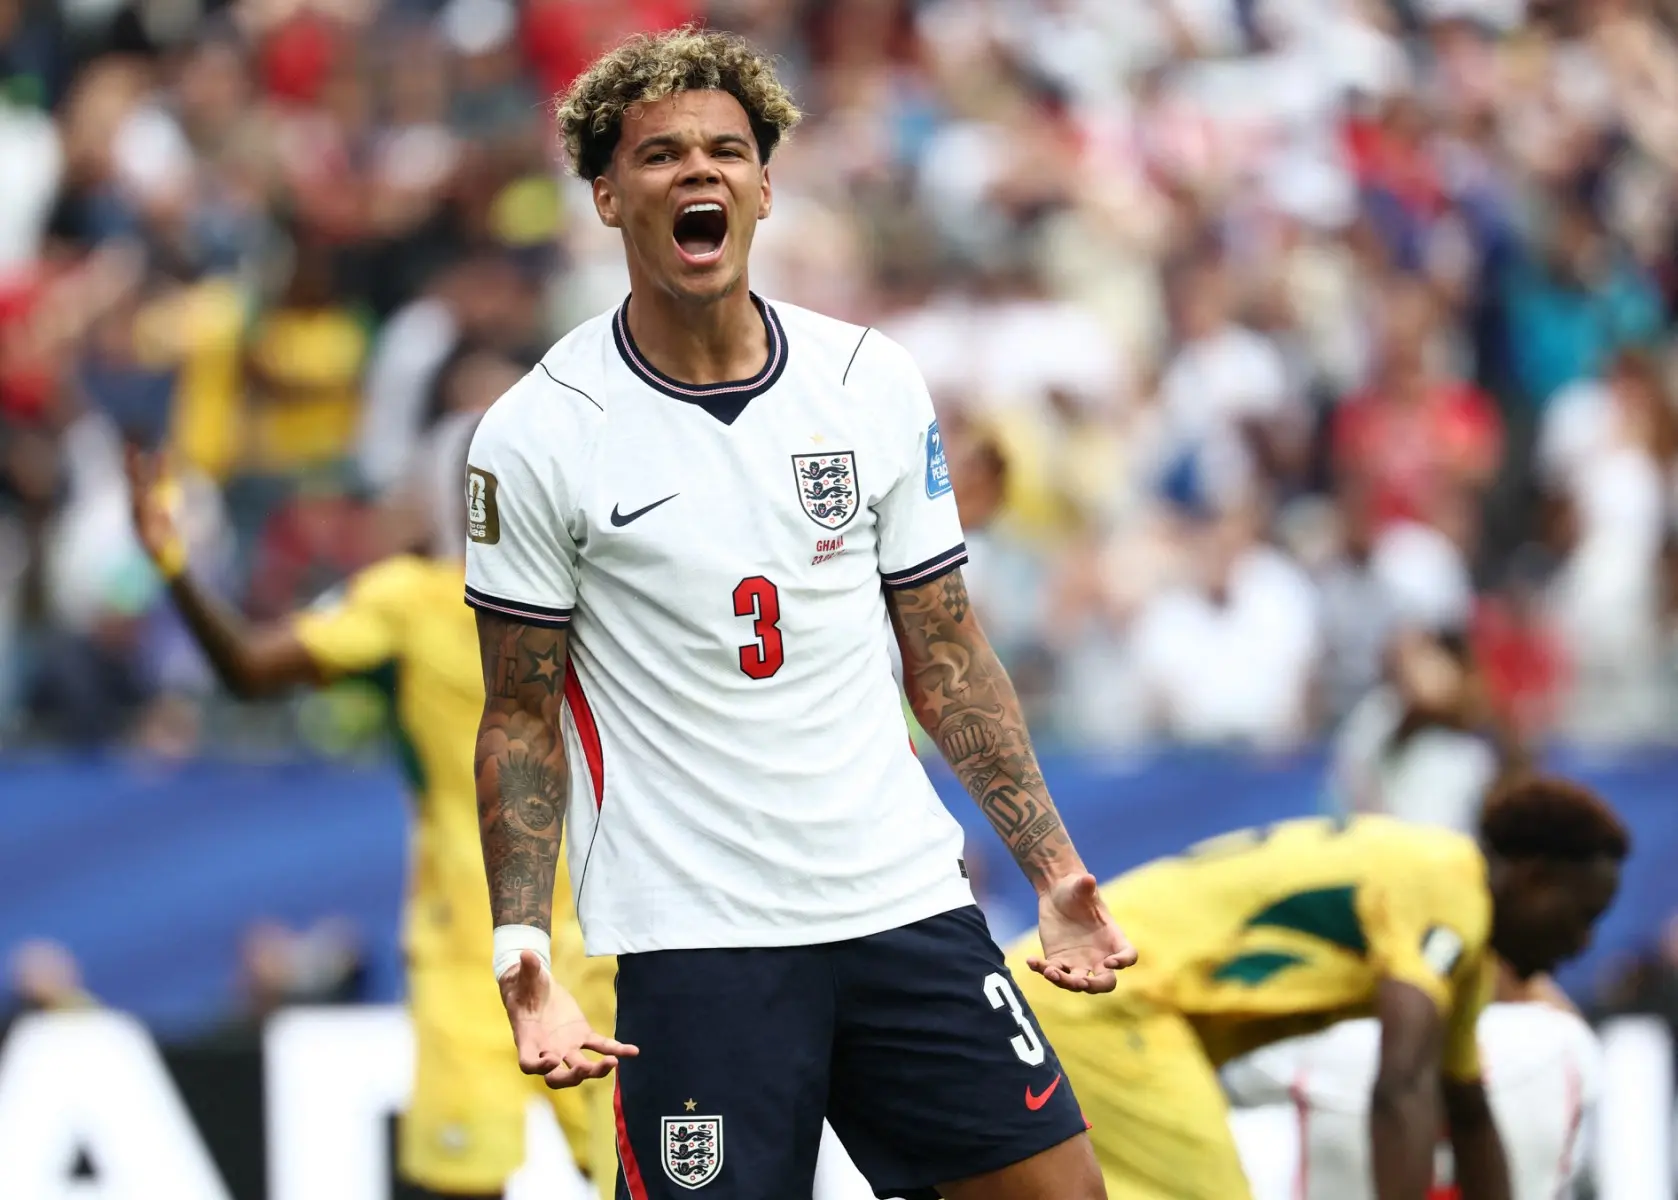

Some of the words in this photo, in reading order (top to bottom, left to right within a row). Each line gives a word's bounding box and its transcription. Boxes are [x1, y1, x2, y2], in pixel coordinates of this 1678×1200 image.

[932, 463, 949, 480] PEAC
[732, 575, 784, 680] 3
[983, 972, 1044, 1067] 3
